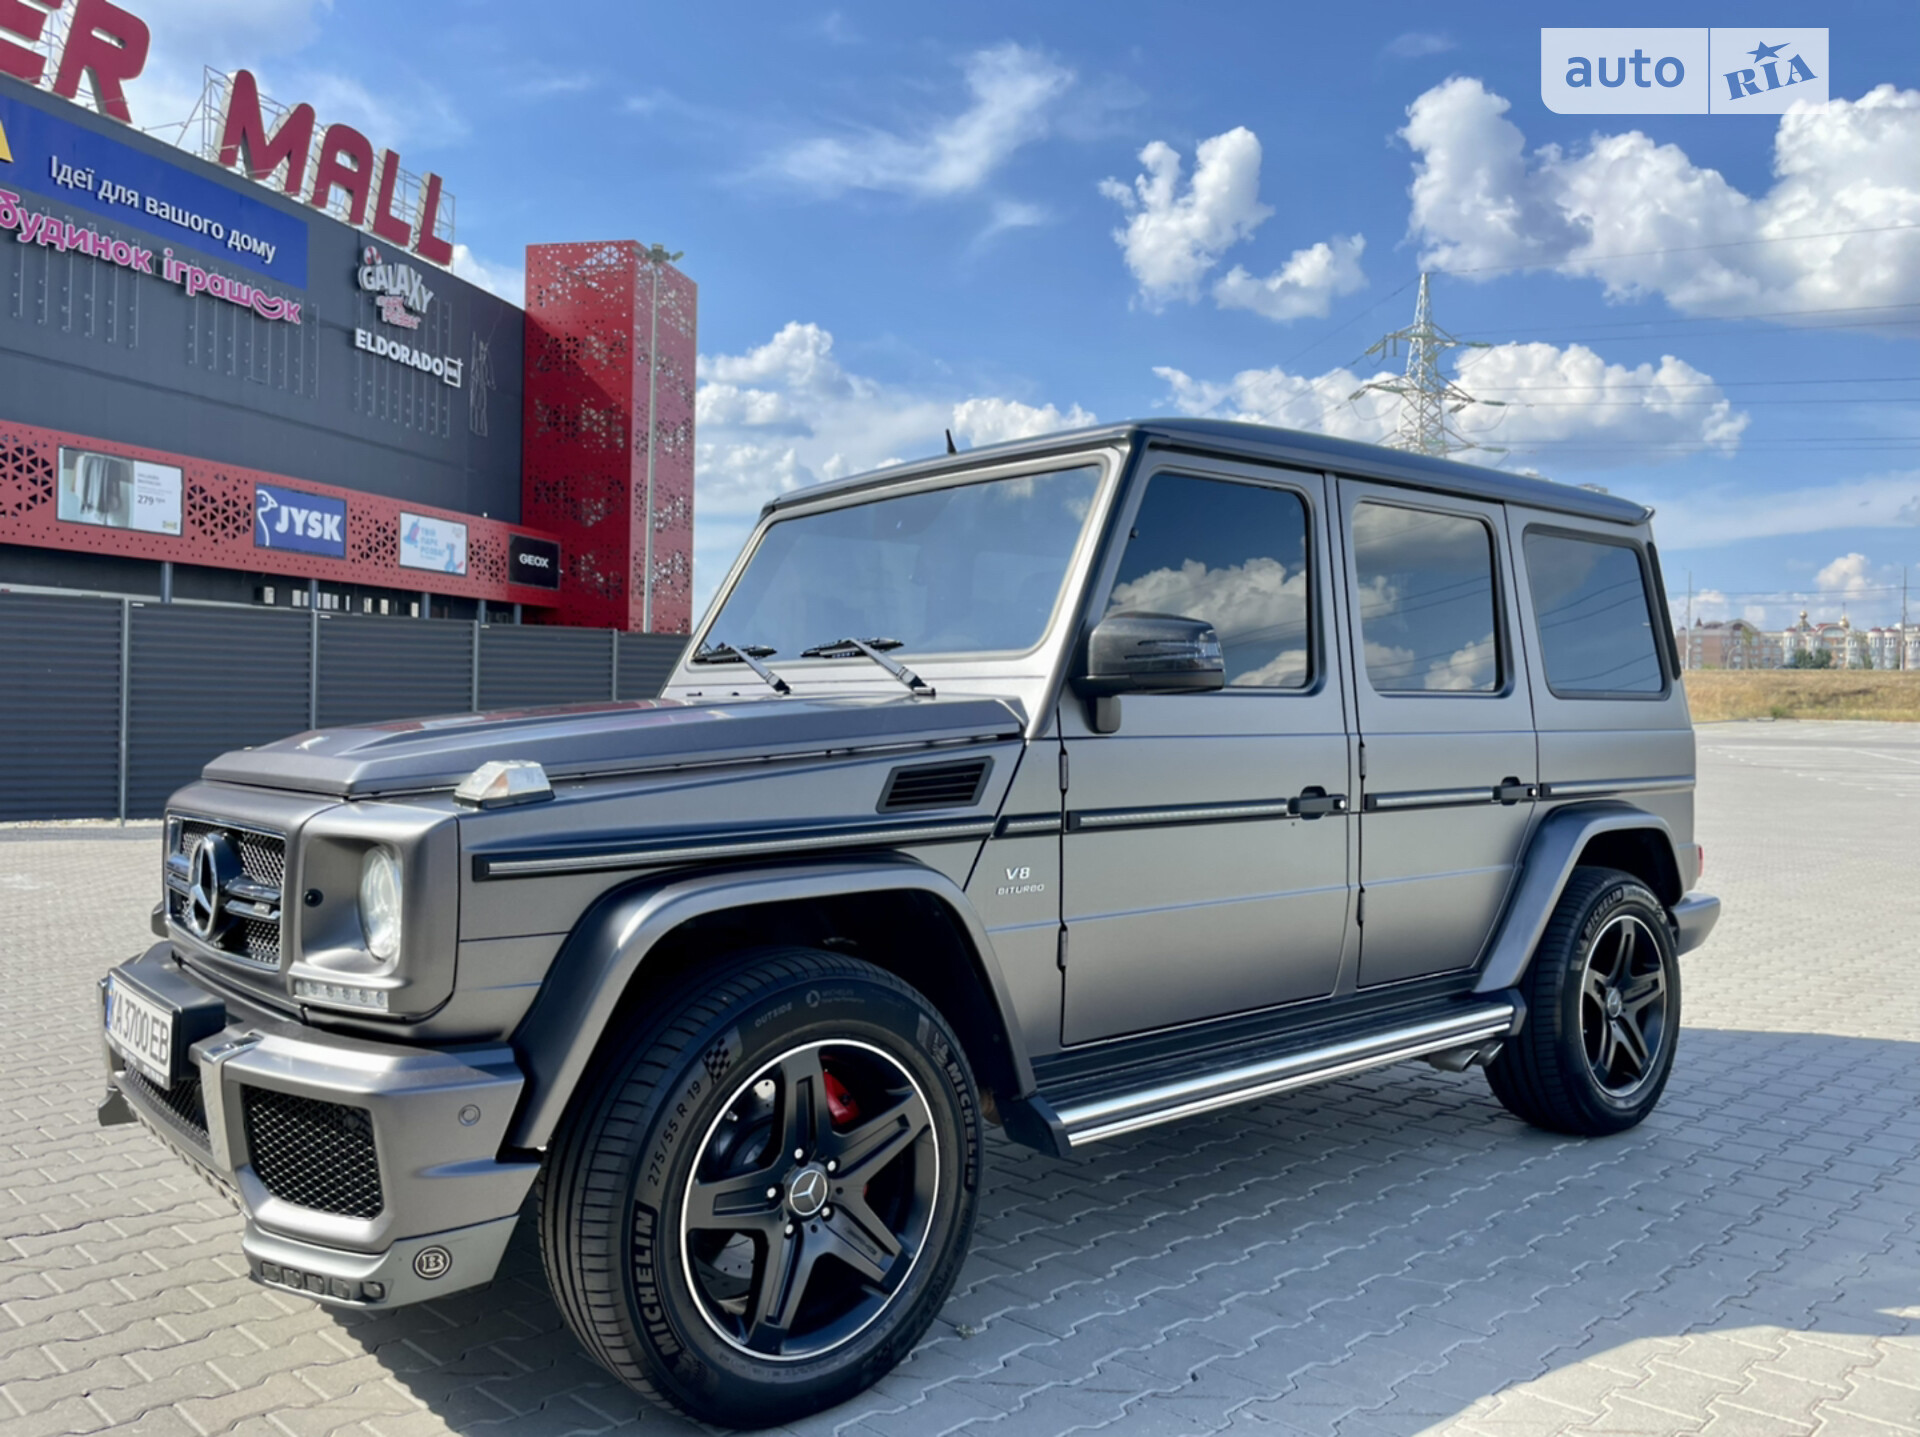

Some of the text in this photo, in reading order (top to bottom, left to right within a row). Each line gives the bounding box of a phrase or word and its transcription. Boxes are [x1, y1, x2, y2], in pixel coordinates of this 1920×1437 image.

[214, 68, 453, 266] MALL
[0, 188, 153, 274] будинок
[50, 155, 276, 264] Ідеї для вашого дому
[358, 262, 434, 314] GALAXY
[355, 327, 444, 376] ELDORADO
[137, 494, 154, 506] 279
[275, 505, 342, 542] JYSK
[519, 553, 549, 568] GEOX
[997, 884, 1045, 896] BITURBO
[1005, 867, 1030, 880] V8
[1584, 887, 1623, 939] MICHELIN
[754, 1002, 792, 1028] OUTSIDE
[648, 1080, 701, 1186] 275/55 R 19
[947, 1061, 977, 1186] MICHELIN
[635, 1209, 680, 1356] MICHELIN
